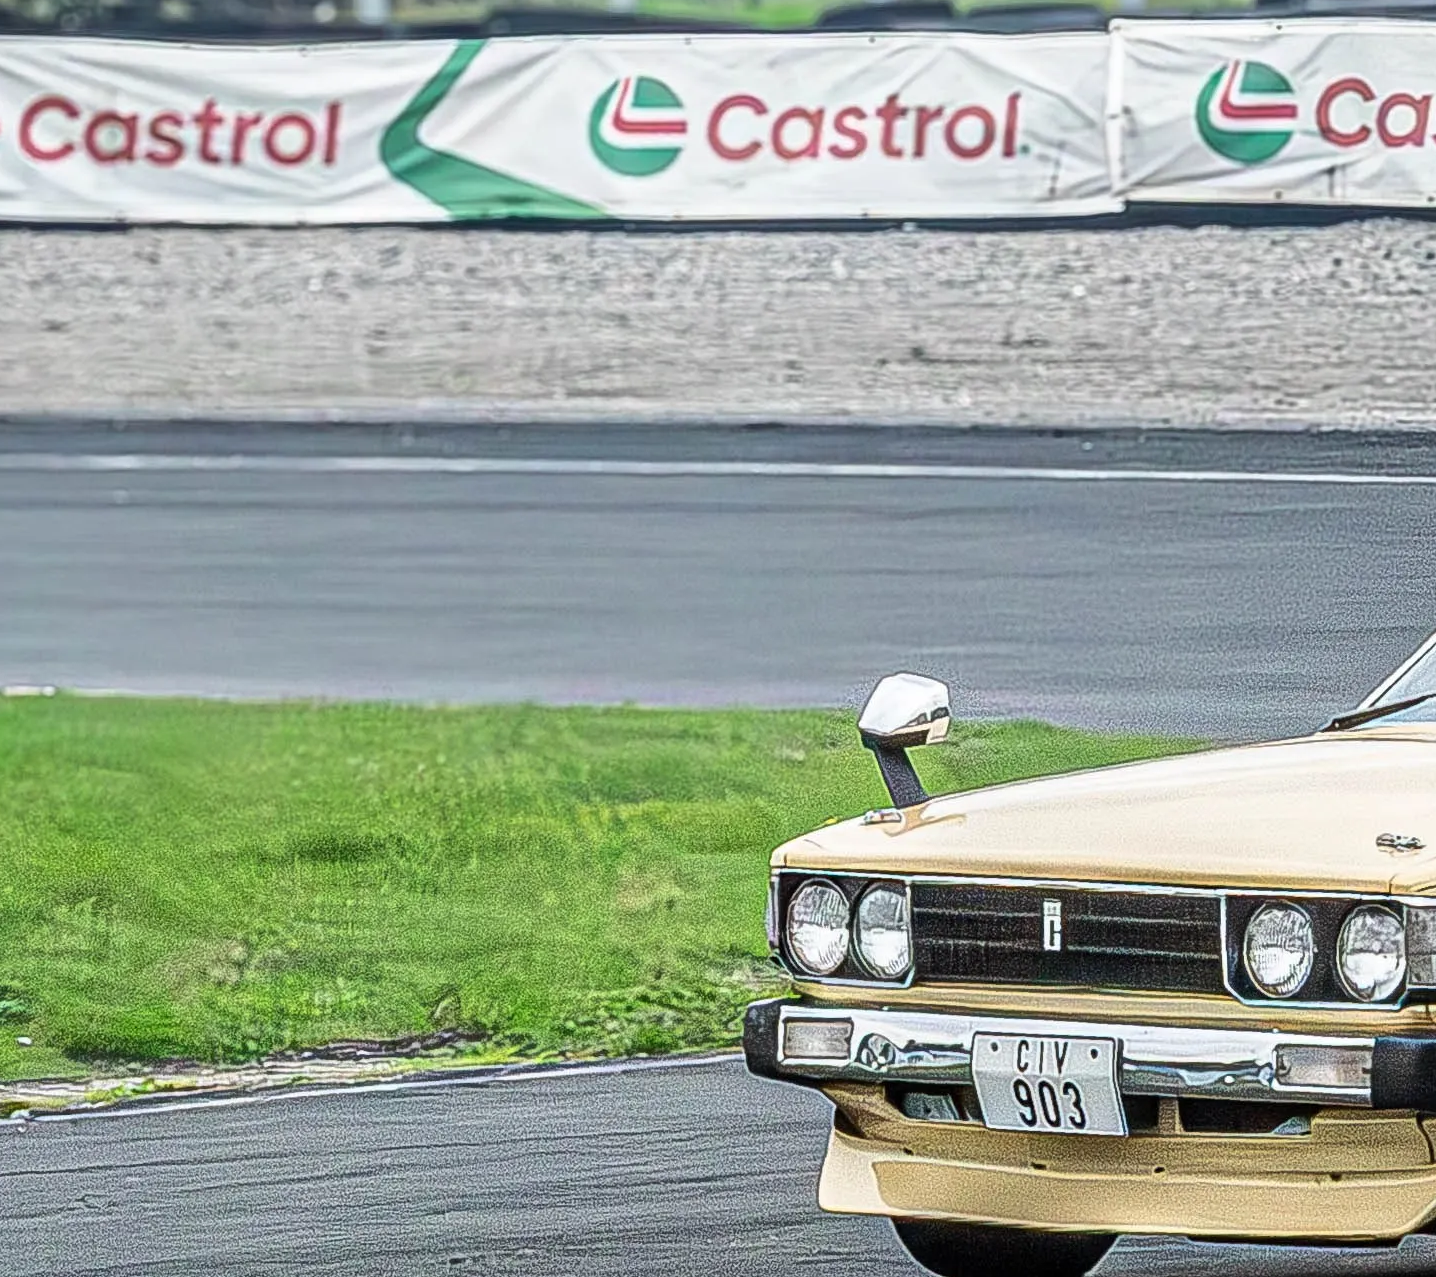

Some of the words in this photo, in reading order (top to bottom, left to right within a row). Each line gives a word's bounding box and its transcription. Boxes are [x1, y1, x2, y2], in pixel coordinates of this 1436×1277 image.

[16, 95, 341, 168] Castrol
[705, 90, 1019, 162] Castrol
[1016, 1039, 1069, 1074] CIV
[1013, 1078, 1087, 1130] 903
